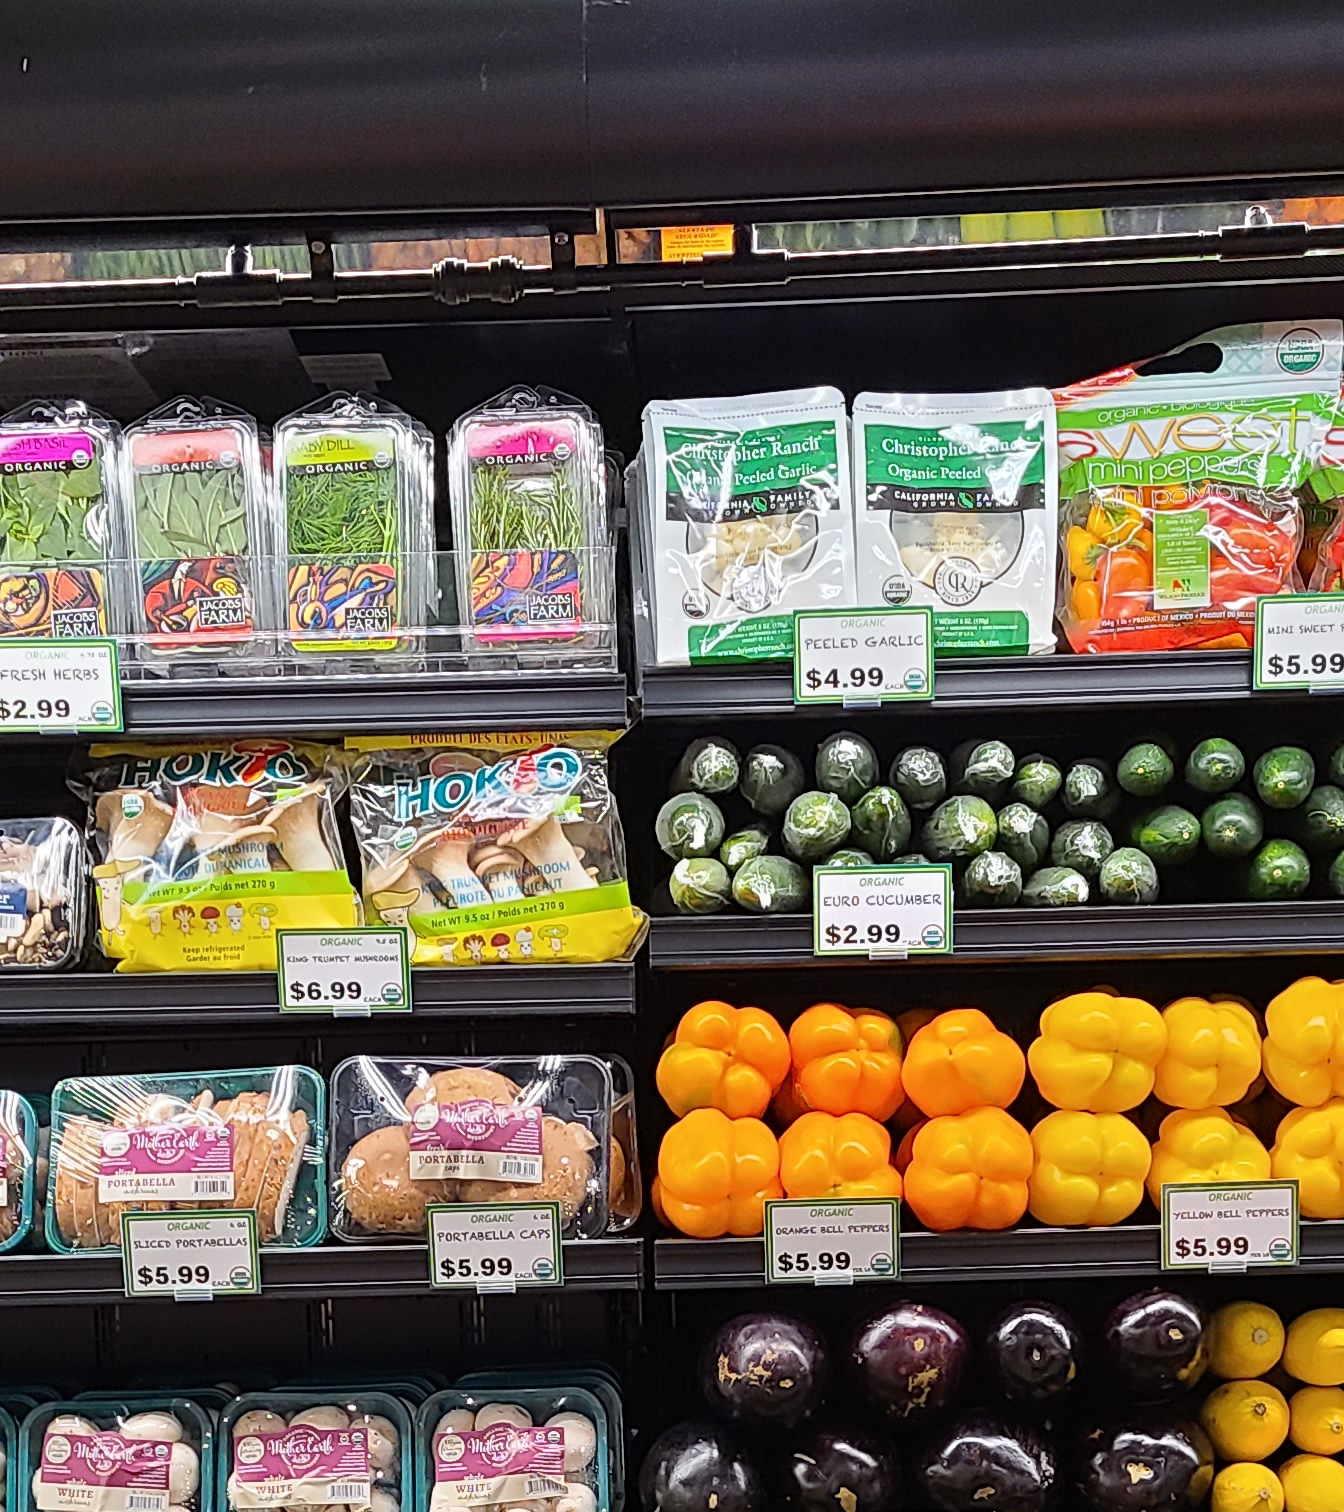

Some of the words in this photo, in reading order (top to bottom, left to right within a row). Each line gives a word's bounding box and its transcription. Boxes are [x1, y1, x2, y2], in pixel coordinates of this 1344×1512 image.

[1059, 409, 1309, 460] sweet
[306, 462, 368, 473] ORGANIC
[735, 470, 774, 485] Peeled
[778, 464, 817, 482] Garlic
[888, 464, 938, 481] Organic
[941, 464, 981, 479] Peeled
[1089, 460, 1143, 483] mini
[1149, 456, 1261, 484] peppers
[529, 605, 571, 619] FARM
[840, 618, 886, 629] ORGANIC
[1267, 624, 1294, 635] MINI
[1298, 623, 1335, 634] SWEET
[805, 636, 858, 650] PEELED
[865, 634, 924, 648] GARLIC
[1268, 653, 1344, 677] $5.99
[0, 669, 46, 681] FRESH
[54, 668, 100, 680] HERBS
[806, 666, 884, 690] $4.99
[859, 877, 904, 887] ORGANIC
[824, 896, 859, 907] EURO
[866, 894, 942, 906] CUCUMBER
[825, 924, 900, 946] $2.99
[183, 946, 200, 954] Keep
[202, 944, 245, 954] refrigerated
[290, 981, 362, 1003] $6.99
[418, 1155, 485, 1166] PORTABELLA
[1173, 1211, 1213, 1221] YELLOW
[1217, 1210, 1241, 1218] BELL
[1246, 1209, 1289, 1218] PEPPERS
[437, 1229, 515, 1243] PORTABELLA
[519, 1228, 551, 1240] CAPS
[776, 1226, 816, 1235] ORANGE
[820, 1225, 844, 1234] BELL
[848, 1224, 889, 1233] PEPPERS
[1175, 1237, 1249, 1259] $5.99
[439, 1258, 512, 1281] $5.99
[777, 1252, 850, 1273] $5.99
[137, 1264, 210, 1288] $5.99
[256, 1482, 294, 1496] WHITE
